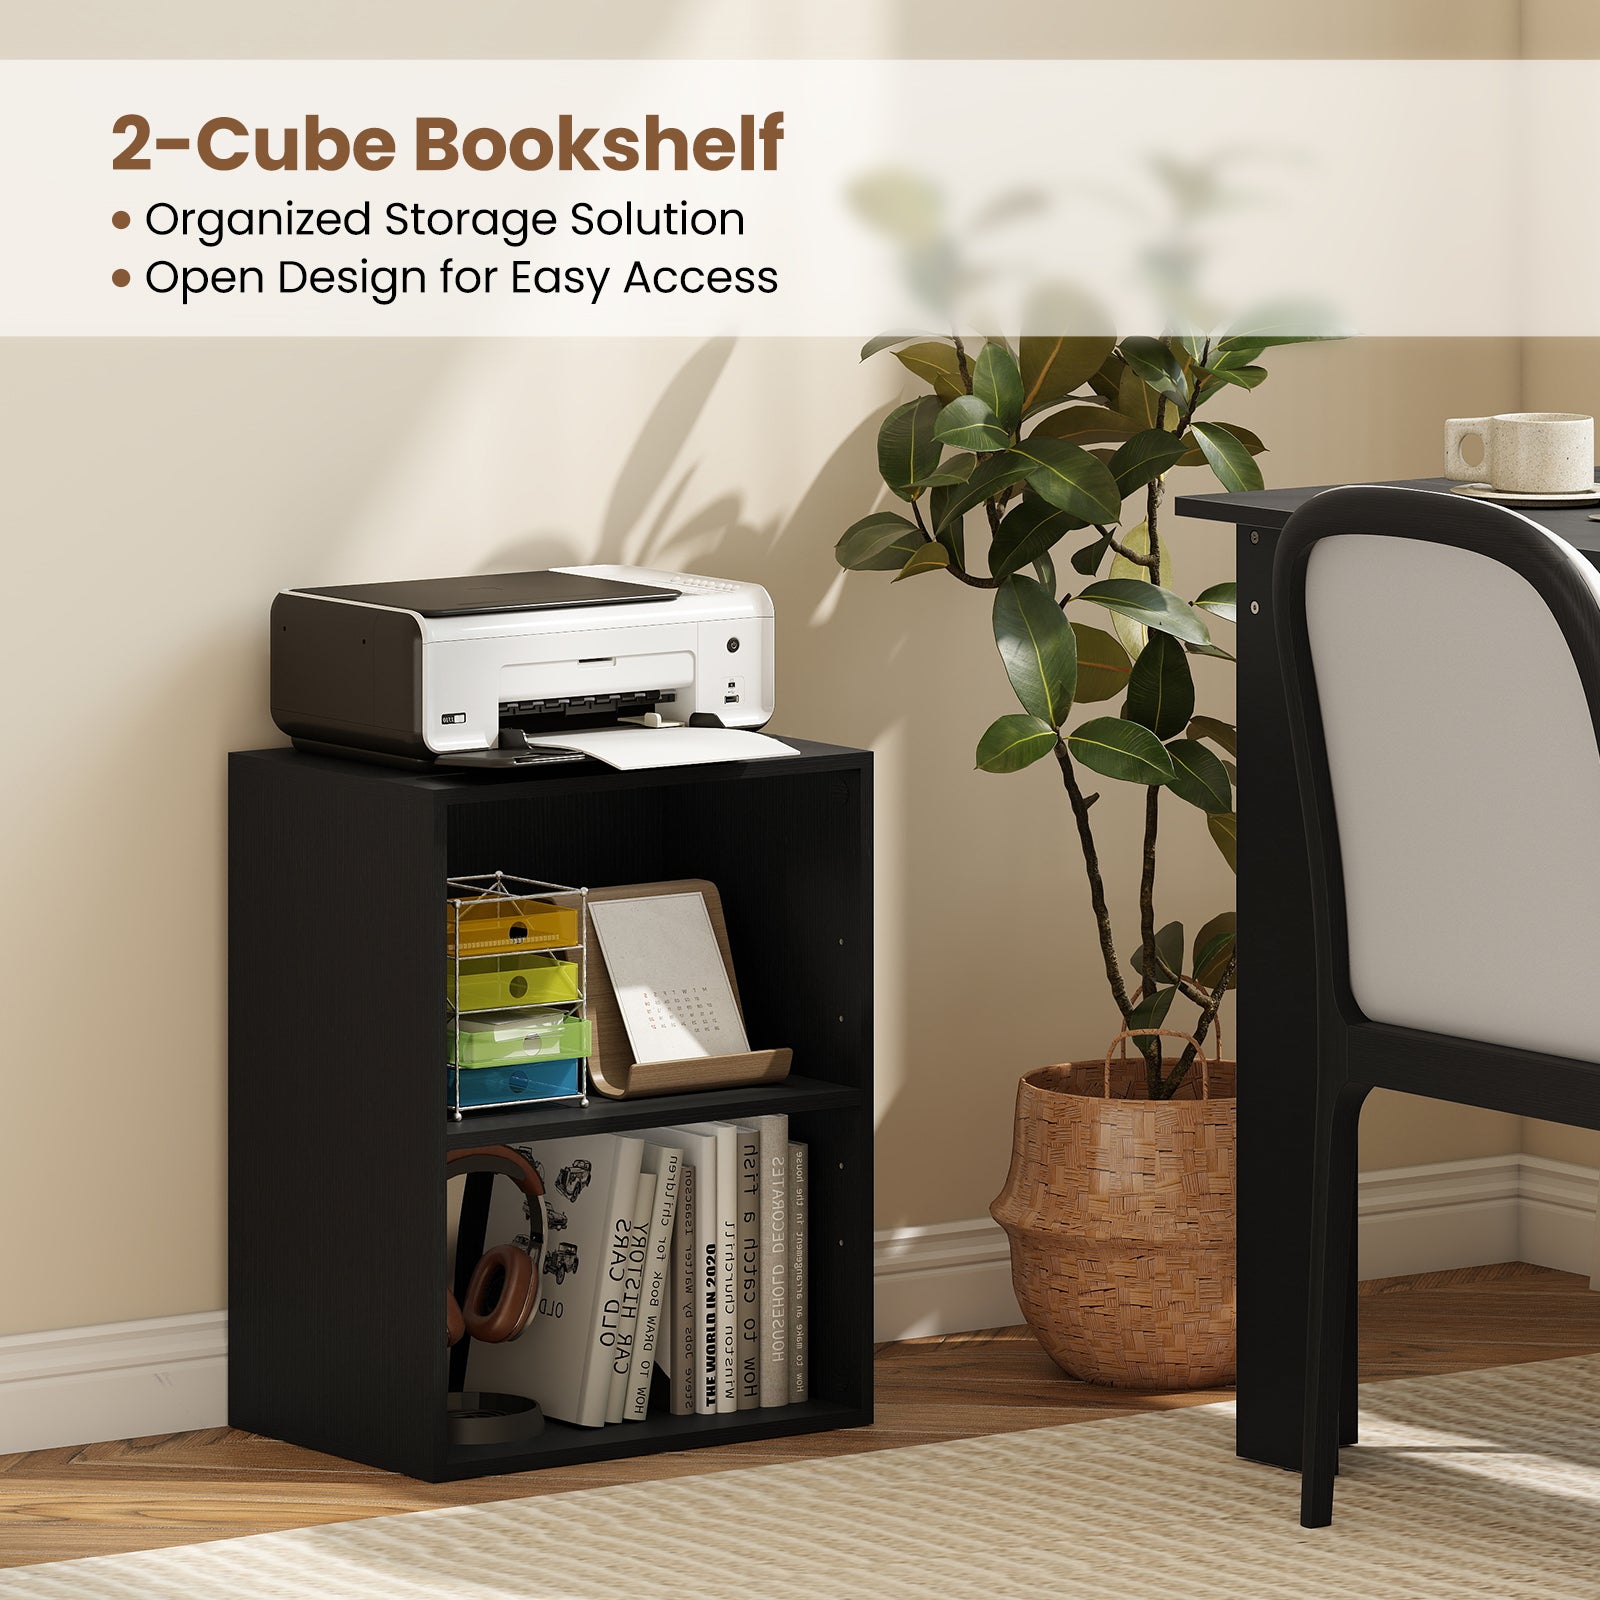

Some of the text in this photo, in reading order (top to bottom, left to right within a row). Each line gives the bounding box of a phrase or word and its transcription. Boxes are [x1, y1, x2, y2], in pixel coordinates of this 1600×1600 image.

[706, 1244, 716, 1407] THE WORLD IN 2020
